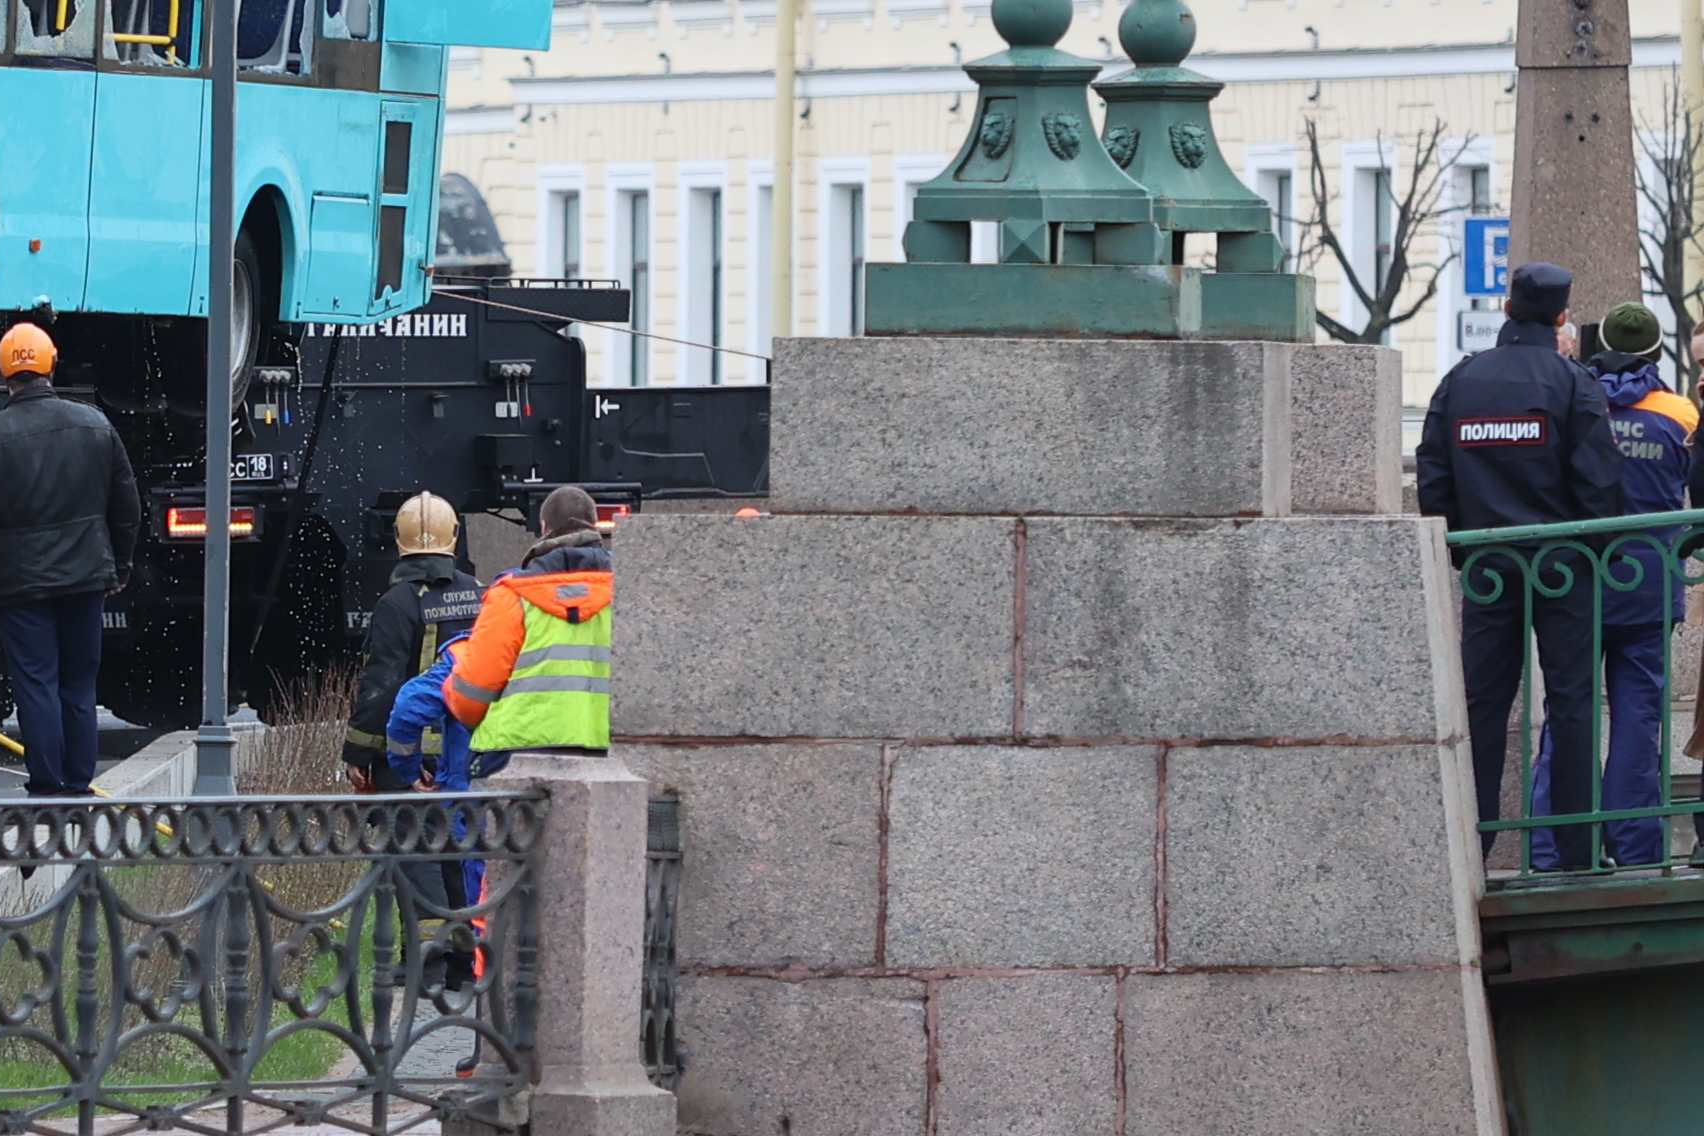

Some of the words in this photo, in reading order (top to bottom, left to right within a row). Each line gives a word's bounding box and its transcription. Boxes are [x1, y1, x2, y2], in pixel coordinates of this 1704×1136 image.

[1460, 422, 1541, 442] ПОЛИЦИЯ
[250, 456, 267, 471] 18
[442, 590, 478, 603] СЛУЖБА
